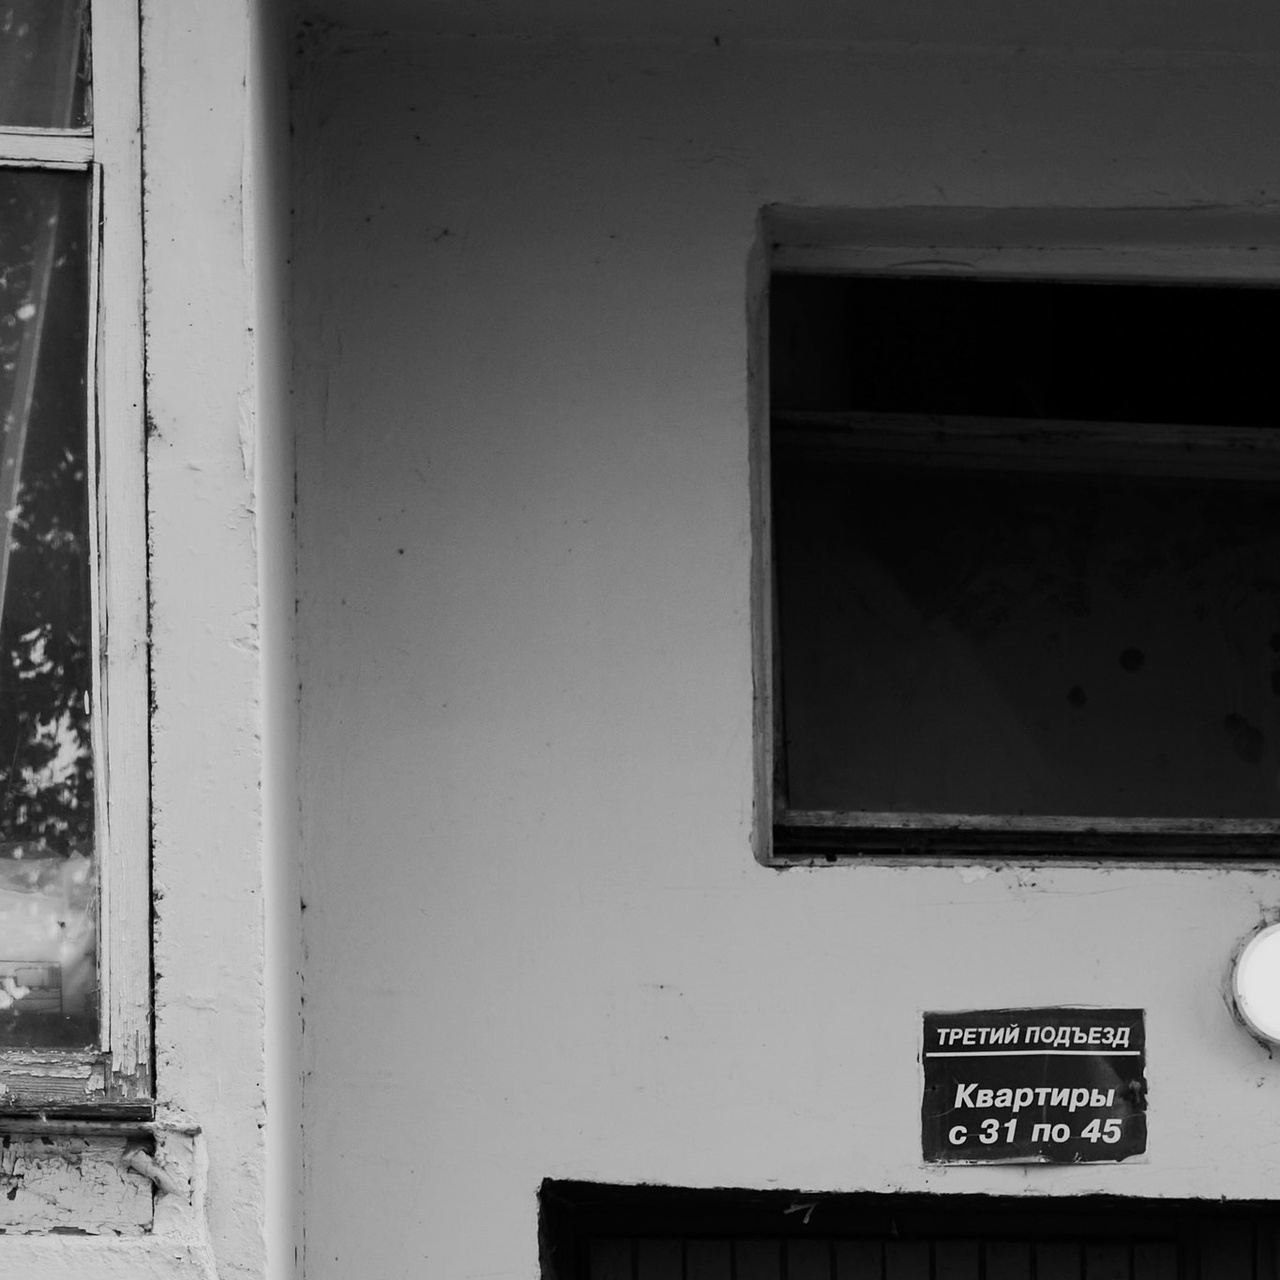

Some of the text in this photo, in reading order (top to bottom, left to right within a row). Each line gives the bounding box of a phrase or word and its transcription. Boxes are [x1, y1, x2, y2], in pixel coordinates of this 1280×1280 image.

[937, 1024, 1131, 1047] ТРЕТИЙ ПОДЪЕЗД
[954, 1083, 1115, 1112] Квартиры
[949, 1119, 1122, 1144] с 31 по 45
